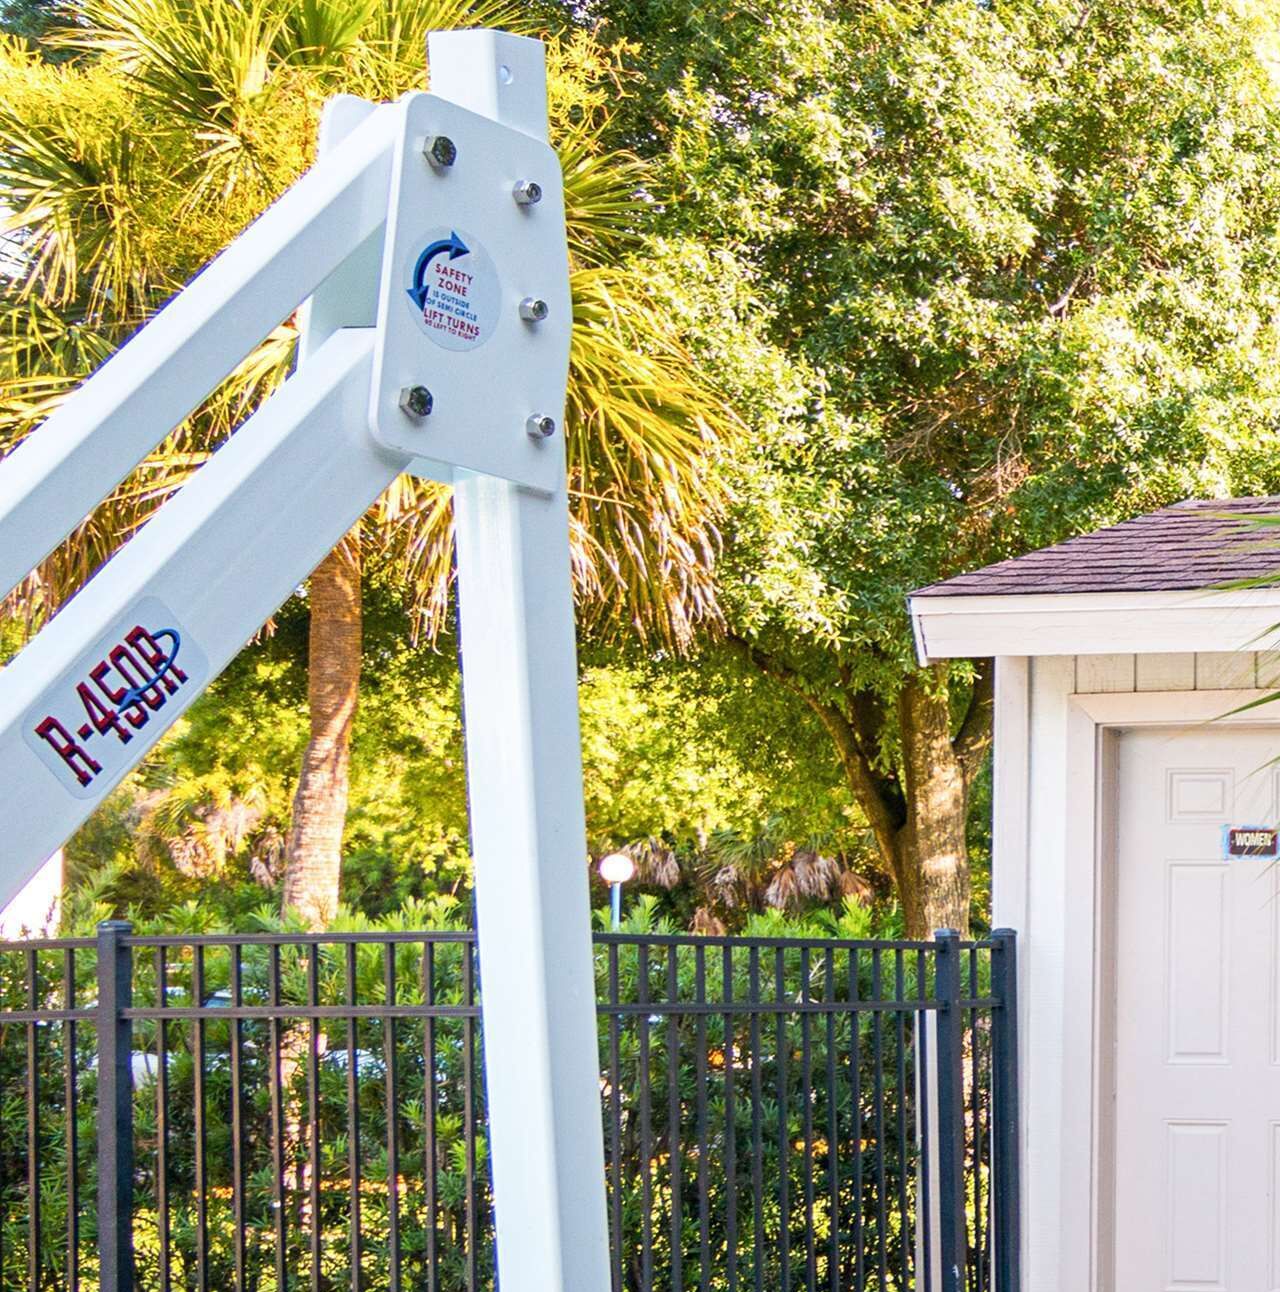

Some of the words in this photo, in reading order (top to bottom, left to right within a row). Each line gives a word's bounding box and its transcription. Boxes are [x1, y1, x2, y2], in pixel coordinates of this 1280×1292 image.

[435, 263, 473, 285] SAFETY
[438, 278, 468, 297] ZONE
[426, 297, 436, 305] OF
[437, 301, 453, 312] SEMI
[455, 307, 477, 322] CIRCLE
[440, 293, 470, 309] OUTSIDE
[424, 307, 444, 323] LIFT
[447, 315, 480, 337] TURNS
[433, 322, 447, 332] LEFT
[35, 625, 189, 788] R-450R
[1235, 832, 1272, 847] WOMEN
